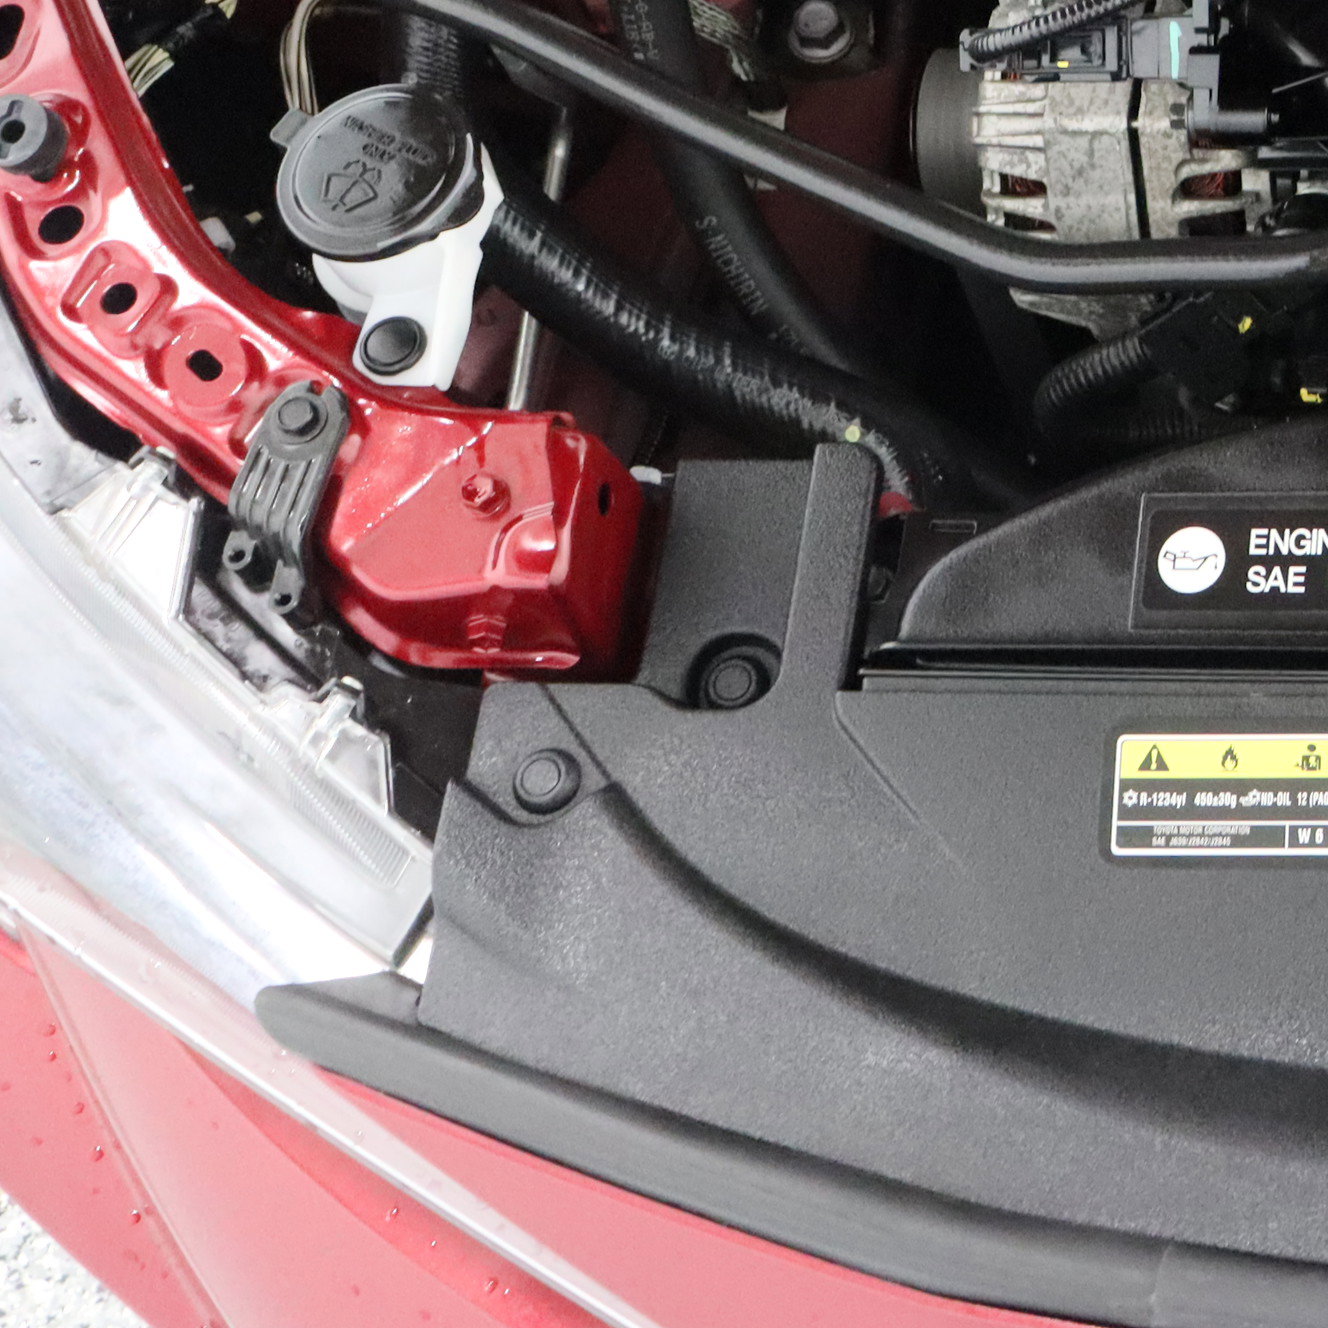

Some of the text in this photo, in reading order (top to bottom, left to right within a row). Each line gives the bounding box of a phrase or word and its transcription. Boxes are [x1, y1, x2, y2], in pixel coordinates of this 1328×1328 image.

[1246, 566, 1307, 595] SAE
[1297, 791, 1308, 807] 12
[1298, 828, 1324, 844] W 6
